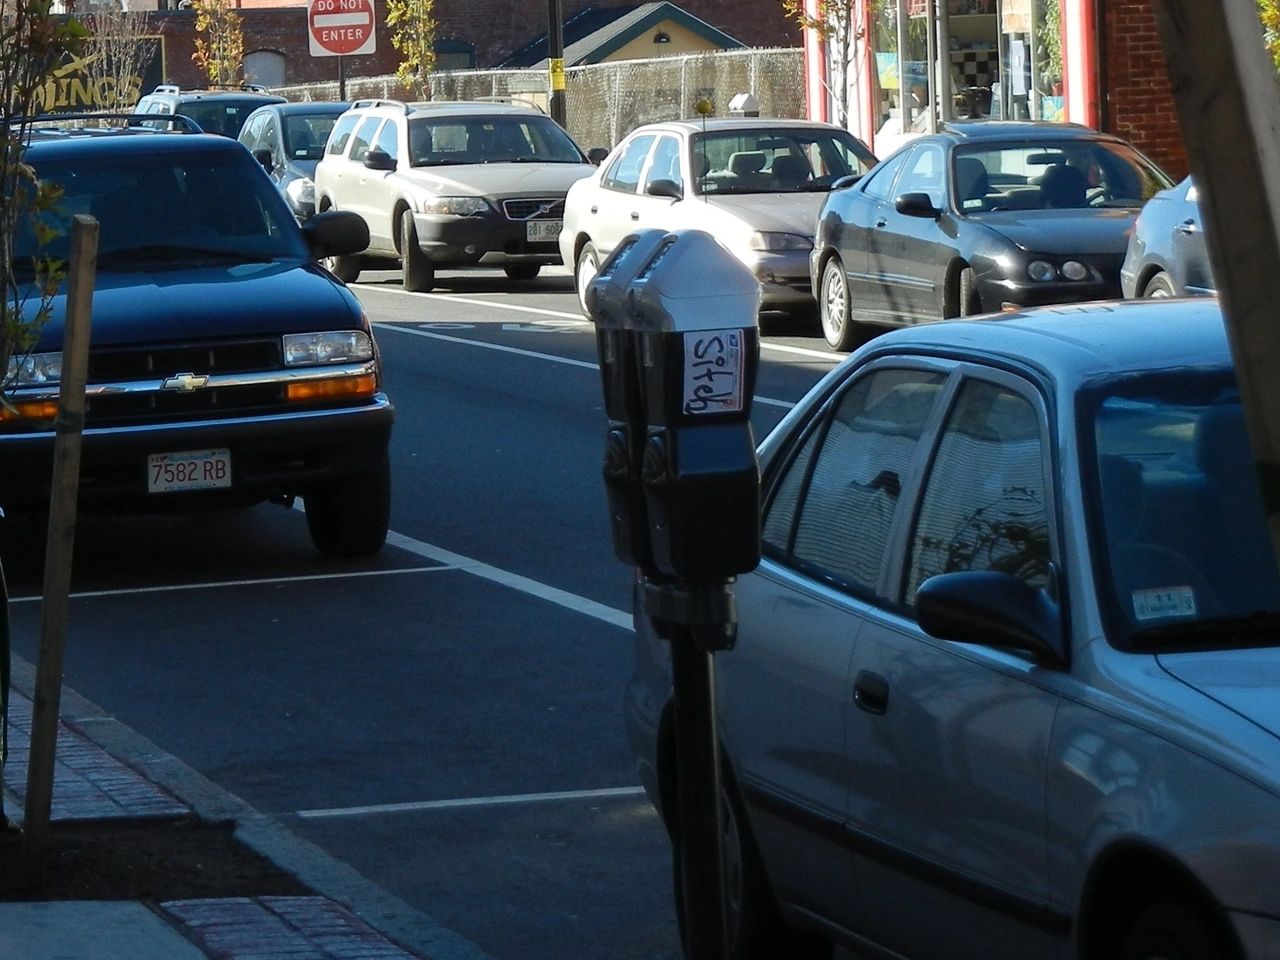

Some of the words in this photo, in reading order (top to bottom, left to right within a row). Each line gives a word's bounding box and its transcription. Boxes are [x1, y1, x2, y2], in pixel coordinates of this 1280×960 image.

[318, 0, 334, 11] DO
[322, 28, 363, 41] ENTER
[152, 461, 199, 485] 7582
[203, 459, 226, 481] RB
